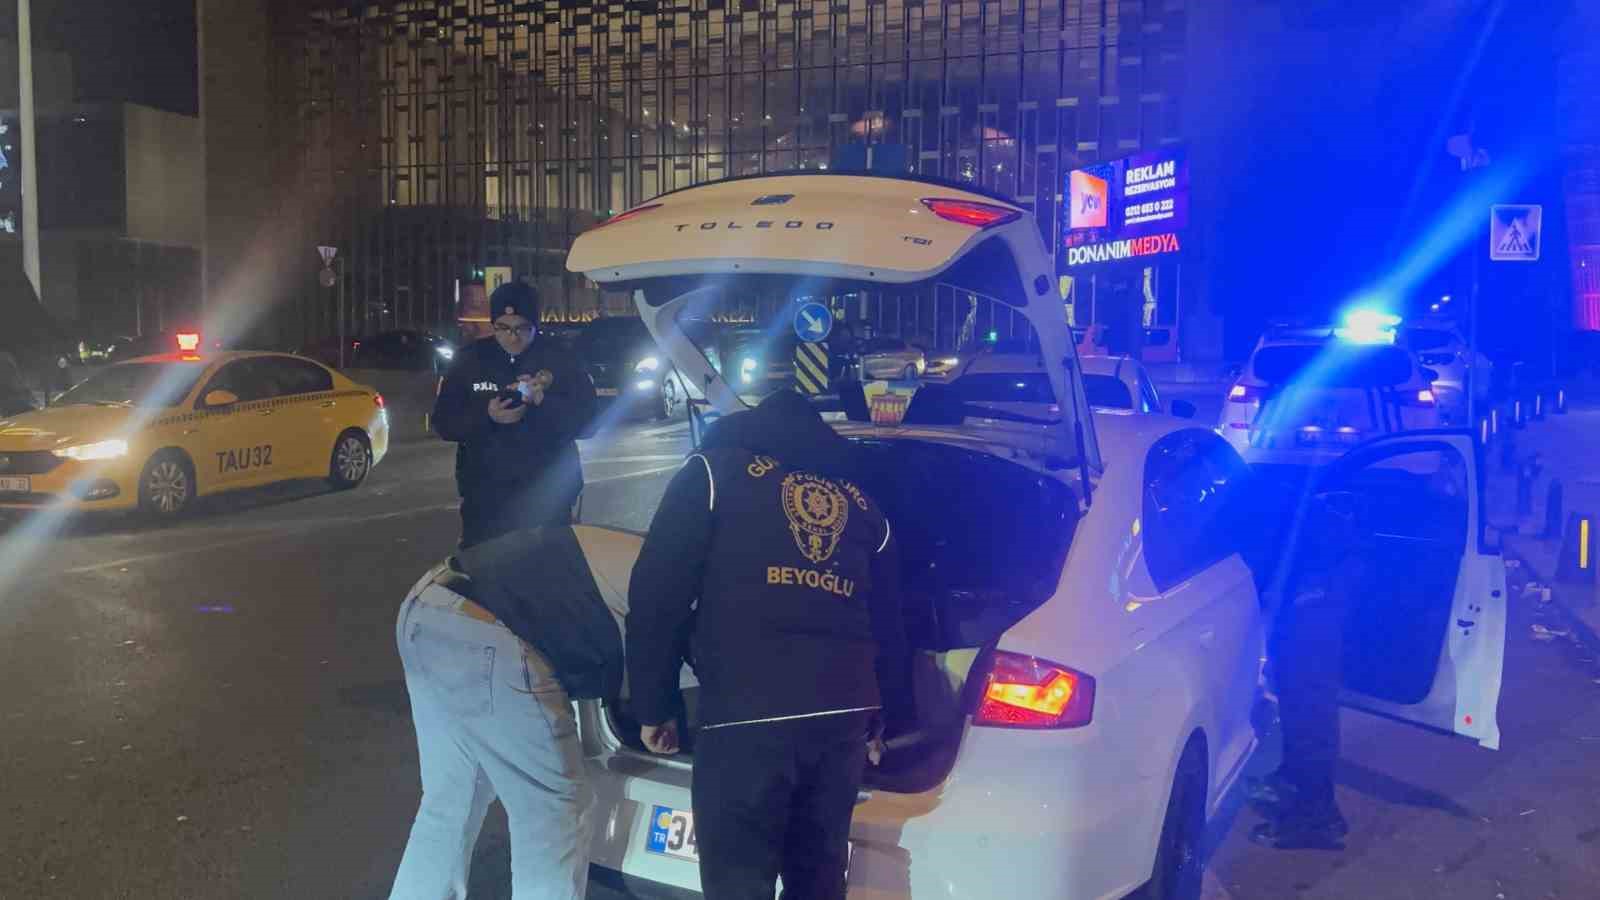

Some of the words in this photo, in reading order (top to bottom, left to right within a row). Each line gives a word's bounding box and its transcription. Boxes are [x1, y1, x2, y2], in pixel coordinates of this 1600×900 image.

[1126, 160, 1174, 185] REKLAM
[674, 220, 834, 233] TOLEDO
[766, 565, 854, 598] BEYOĞLU
[653, 831, 666, 843] TR
